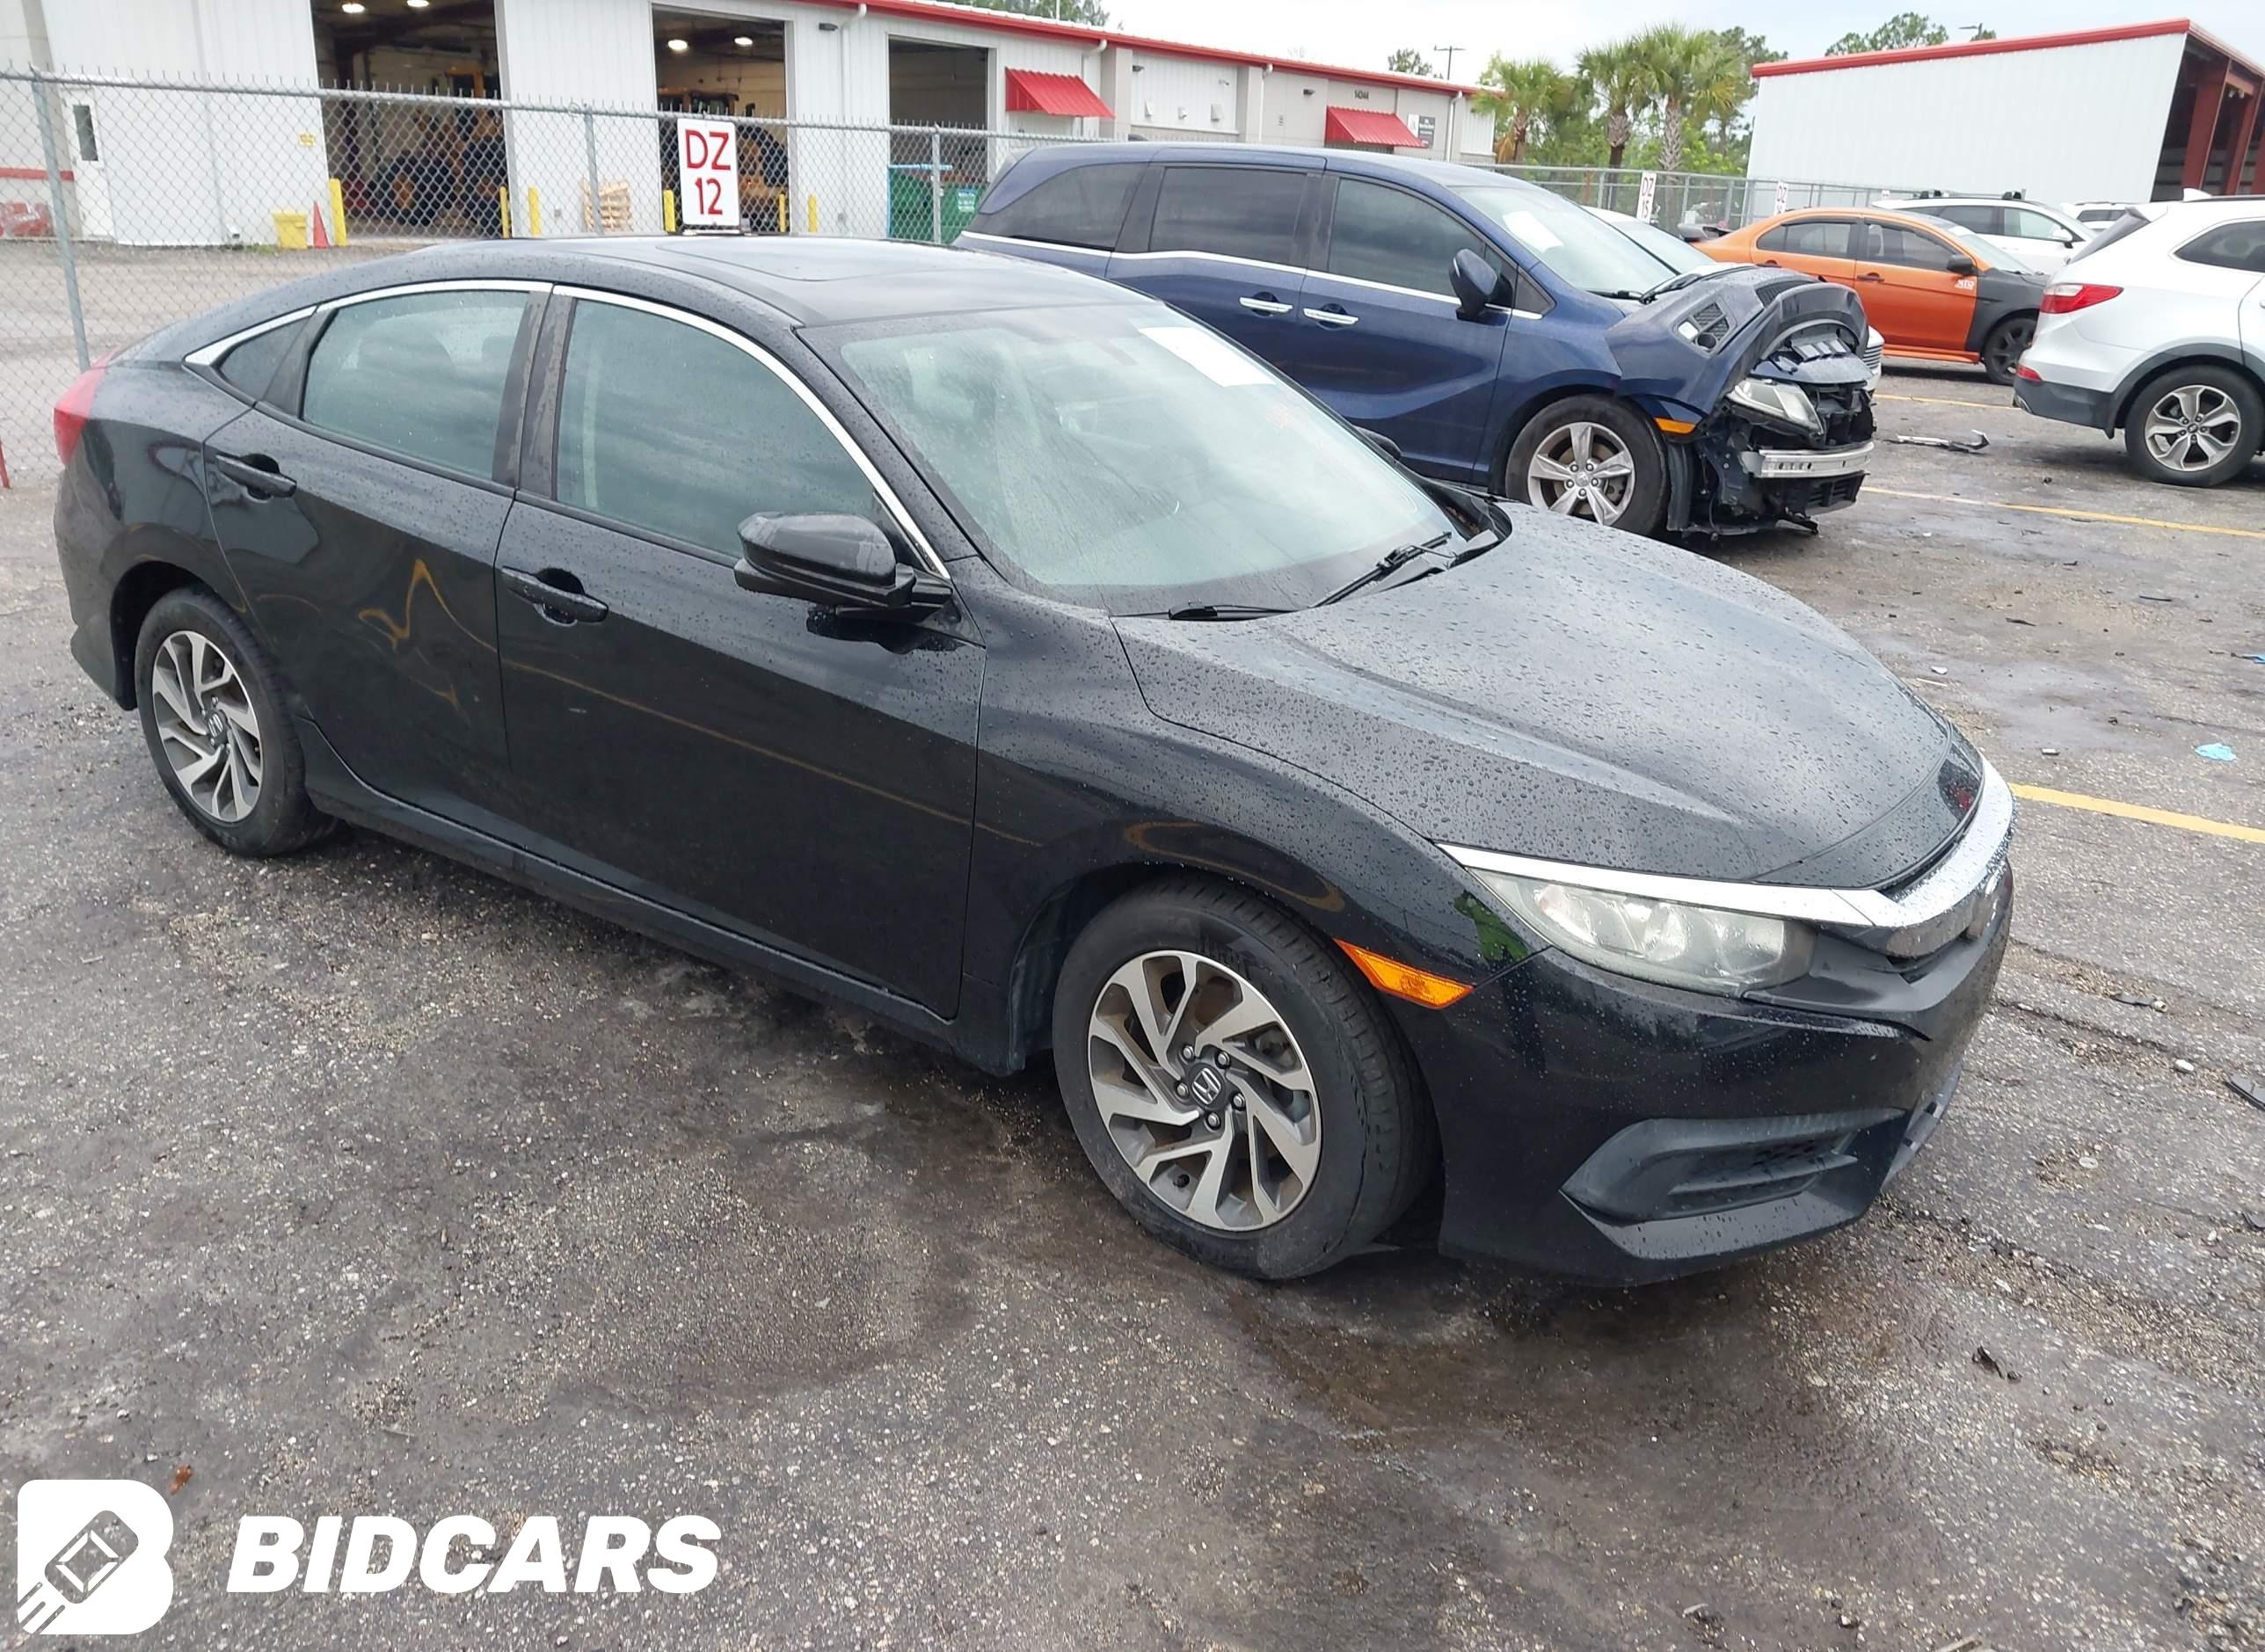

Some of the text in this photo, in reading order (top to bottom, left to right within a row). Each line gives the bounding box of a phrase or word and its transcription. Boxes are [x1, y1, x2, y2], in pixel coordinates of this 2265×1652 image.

[685, 129, 732, 171] DZ
[695, 177, 724, 215] 12
[1642, 177, 1654, 197] DZ
[1641, 200, 1650, 219] 15
